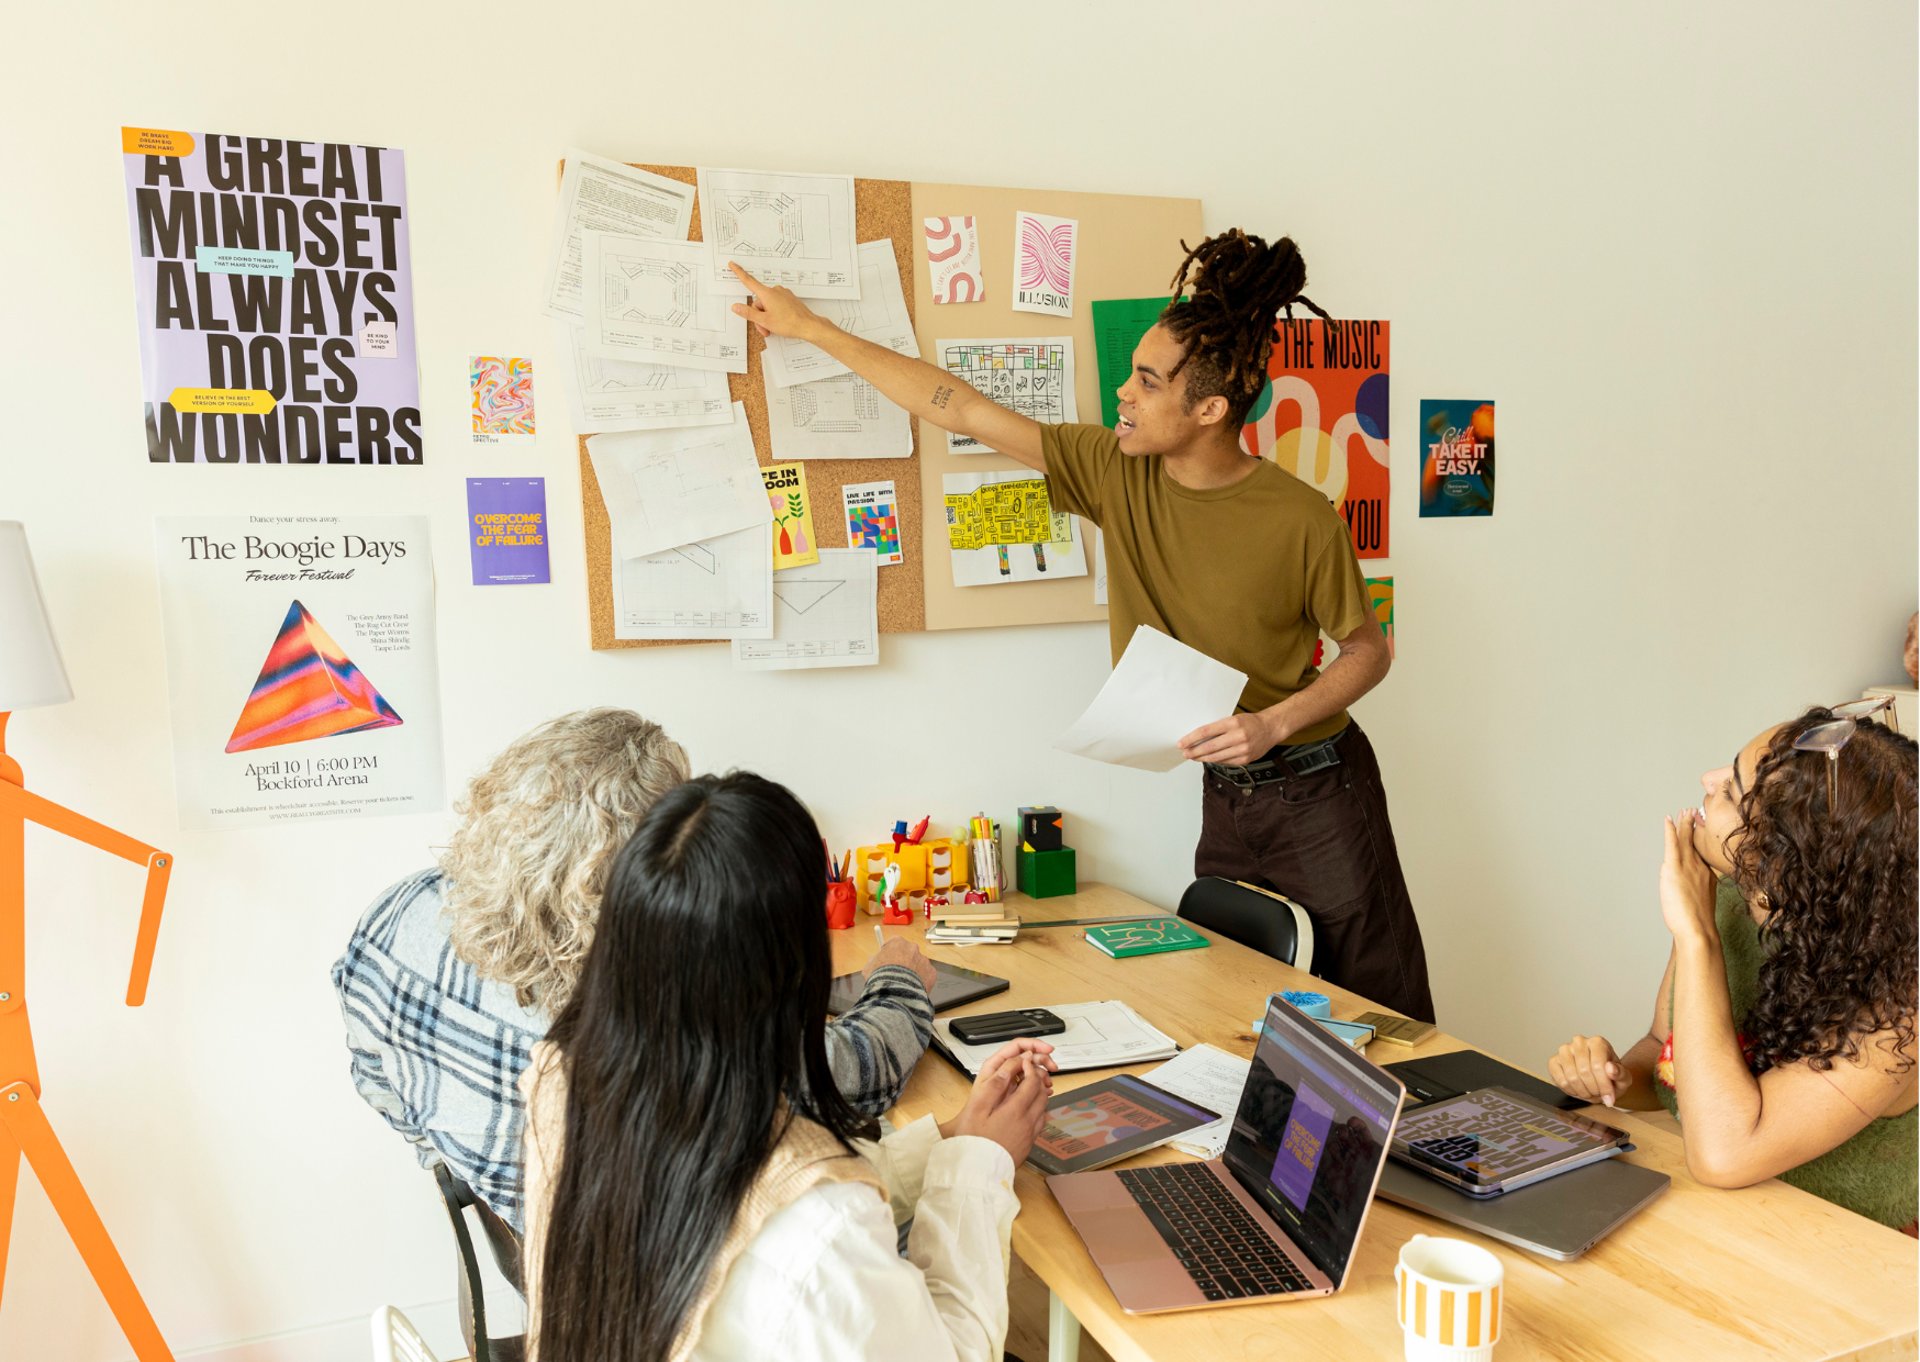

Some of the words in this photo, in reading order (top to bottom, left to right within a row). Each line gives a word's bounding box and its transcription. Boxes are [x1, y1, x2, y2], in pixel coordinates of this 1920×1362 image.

[144, 154, 184, 188] A
[204, 133, 388, 202] GREAT
[136, 187, 402, 271] MINDSET
[155, 260, 399, 336] ALWAYS
[1019, 291, 1069, 309] ILLUSION
[1280, 318, 1314, 369] THE
[1323, 319, 1381, 369] MUSIC
[206, 333, 359, 404] DOES
[144, 400, 424, 465] WONDERS
[1428, 444, 1472, 459] TAKE
[1473, 444, 1488, 459] IT
[780, 468, 797, 479] IN
[1435, 460, 1482, 475] EASY.
[765, 477, 799, 490] OOM
[276, 517, 294, 525] your
[319, 517, 341, 525] away.
[474, 513, 542, 525] OVERCOME
[1344, 499, 1381, 551] YOU
[481, 524, 505, 535] THE
[506, 524, 537, 535] FEAR
[476, 535, 493, 546] OF
[495, 534, 544, 546] FAILURE
[182, 536, 236, 560] The
[244, 535, 336, 566] Boogie
[343, 535, 407, 565] Days
[246, 569, 298, 582] Forever
[298, 568, 356, 581] Festival
[245, 761, 280, 779] April
[285, 760, 301, 774] 10
[316, 758, 349, 772] 6:00
[353, 756, 378, 769] PM
[257, 774, 323, 791] Bockford
[327, 774, 369, 787] Arena
[225, 806, 267, 815] establishment
[275, 802, 307, 810] wheelchair
[341, 798, 364, 806] Reserve
[365, 797, 378, 805] your
